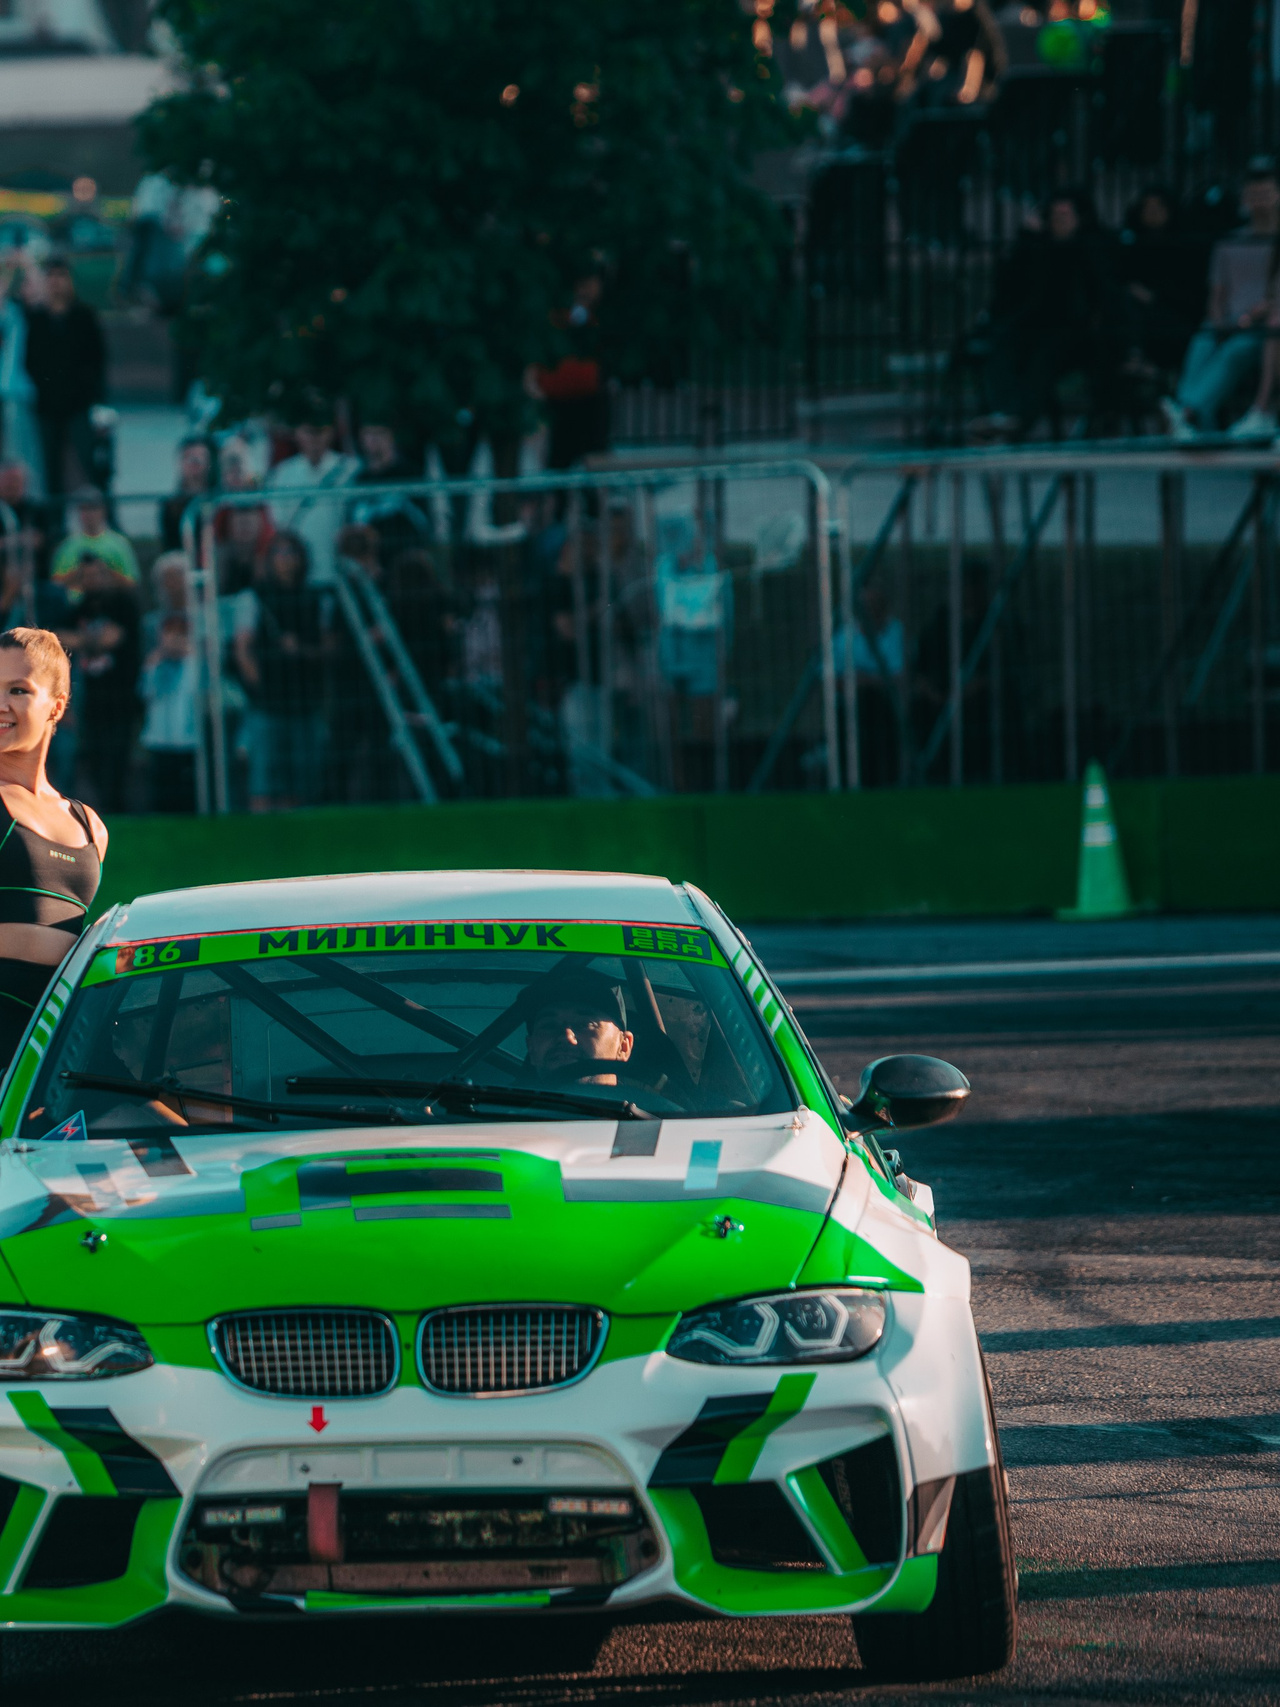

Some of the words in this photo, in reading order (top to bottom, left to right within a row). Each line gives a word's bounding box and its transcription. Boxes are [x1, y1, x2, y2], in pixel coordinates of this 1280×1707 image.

[258, 924, 567, 954] МИЛИНЧУК
[631, 927, 700, 944] BET
[132, 940, 181, 967] 86
